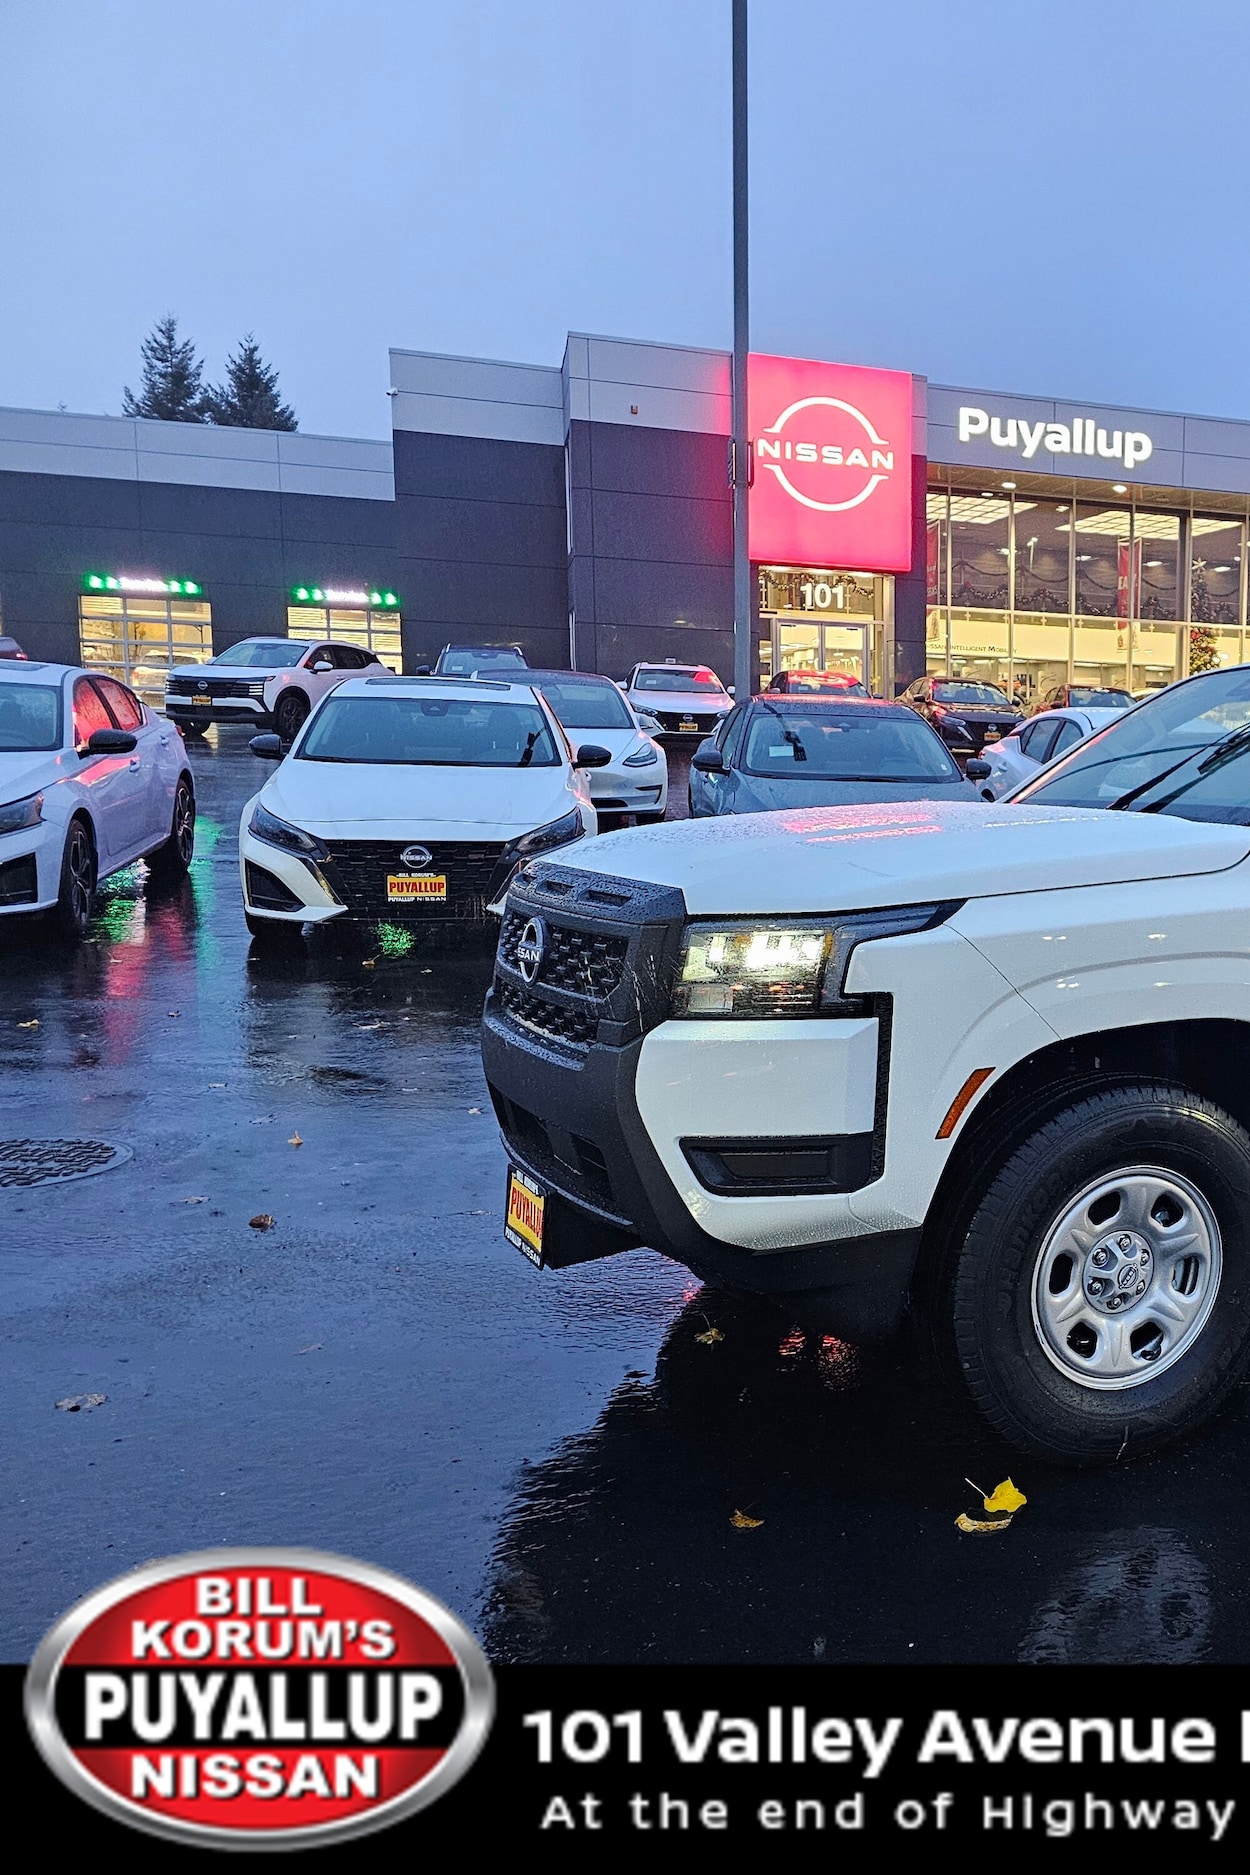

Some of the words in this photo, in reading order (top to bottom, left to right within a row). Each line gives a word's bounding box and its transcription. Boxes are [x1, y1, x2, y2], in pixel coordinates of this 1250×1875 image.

[959, 406, 1153, 469] Puyallup
[757, 438, 894, 470] NISSAN
[800, 582, 844, 609] 101
[400, 853, 433, 861] NISSAN
[389, 881, 445, 893] PUYALLUP
